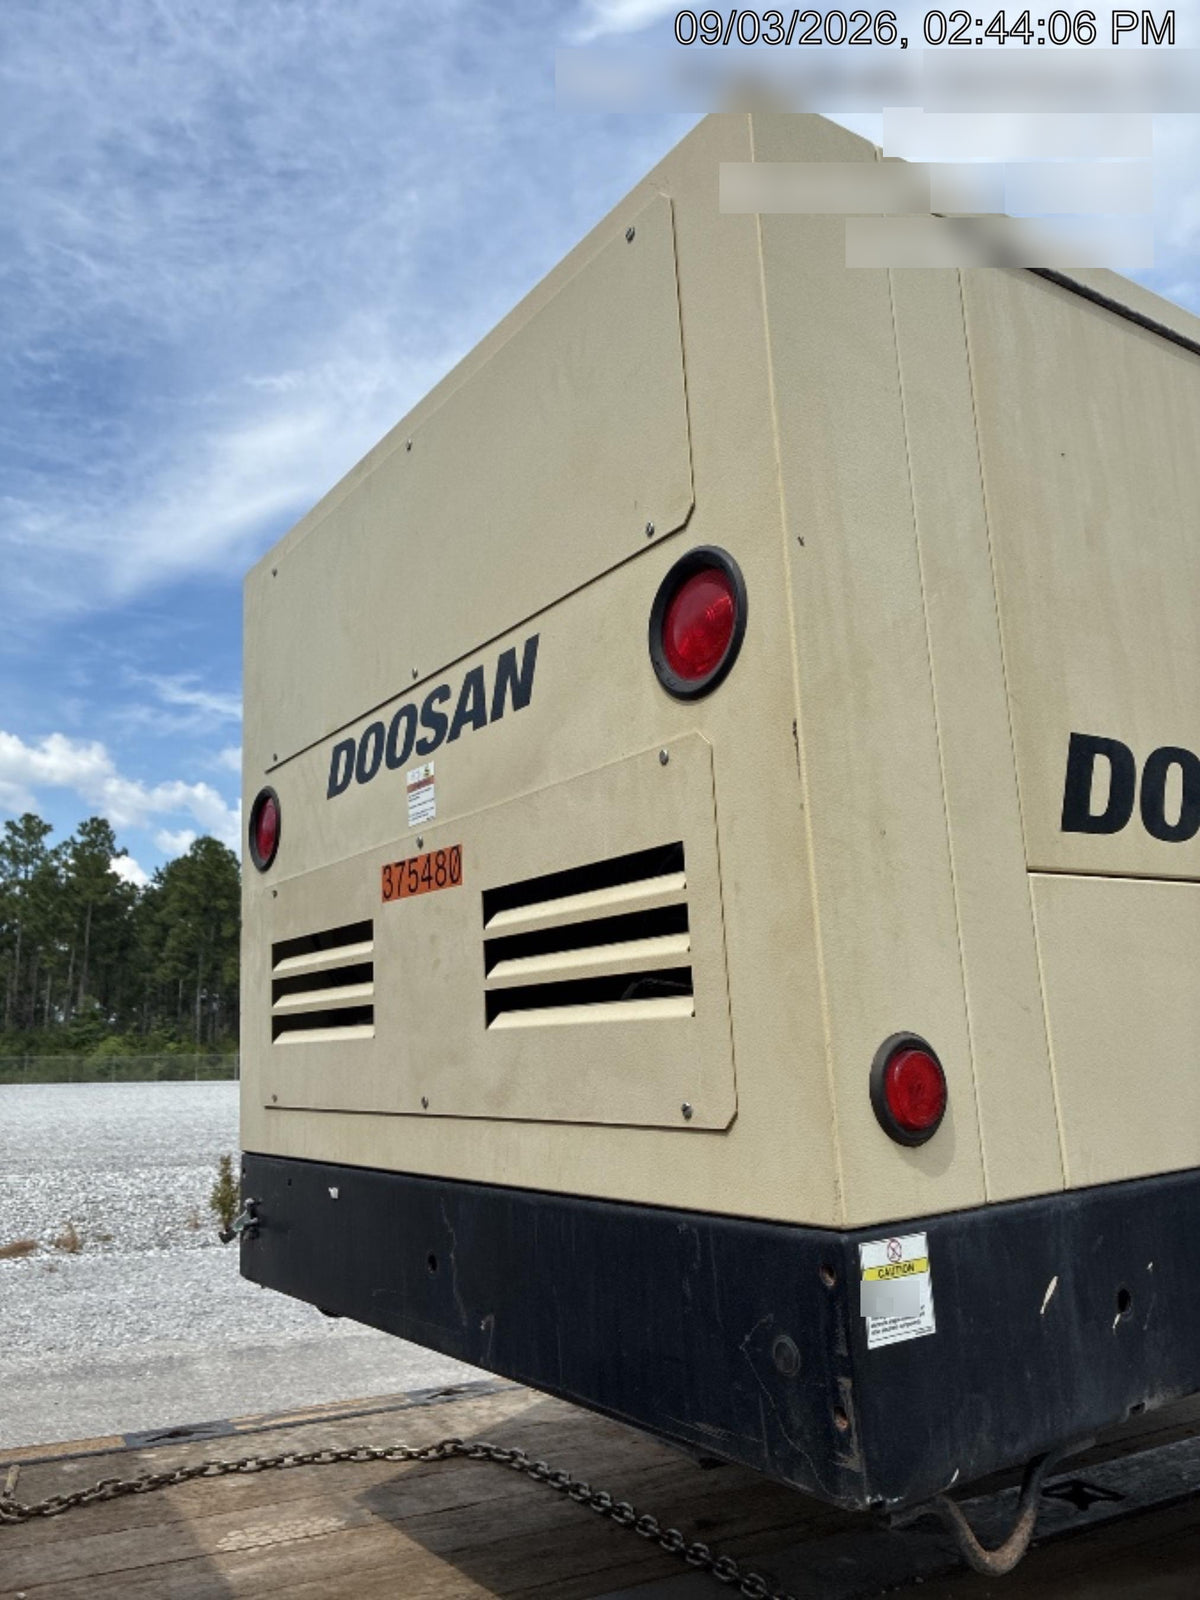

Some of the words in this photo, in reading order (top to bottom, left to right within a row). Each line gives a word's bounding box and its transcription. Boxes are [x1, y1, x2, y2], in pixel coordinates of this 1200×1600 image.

[327, 633, 540, 800] DOOSAN
[1061, 732, 1200, 842] DO
[383, 846, 461, 899] 375480
[877, 1263, 915, 1279] CAUTION
